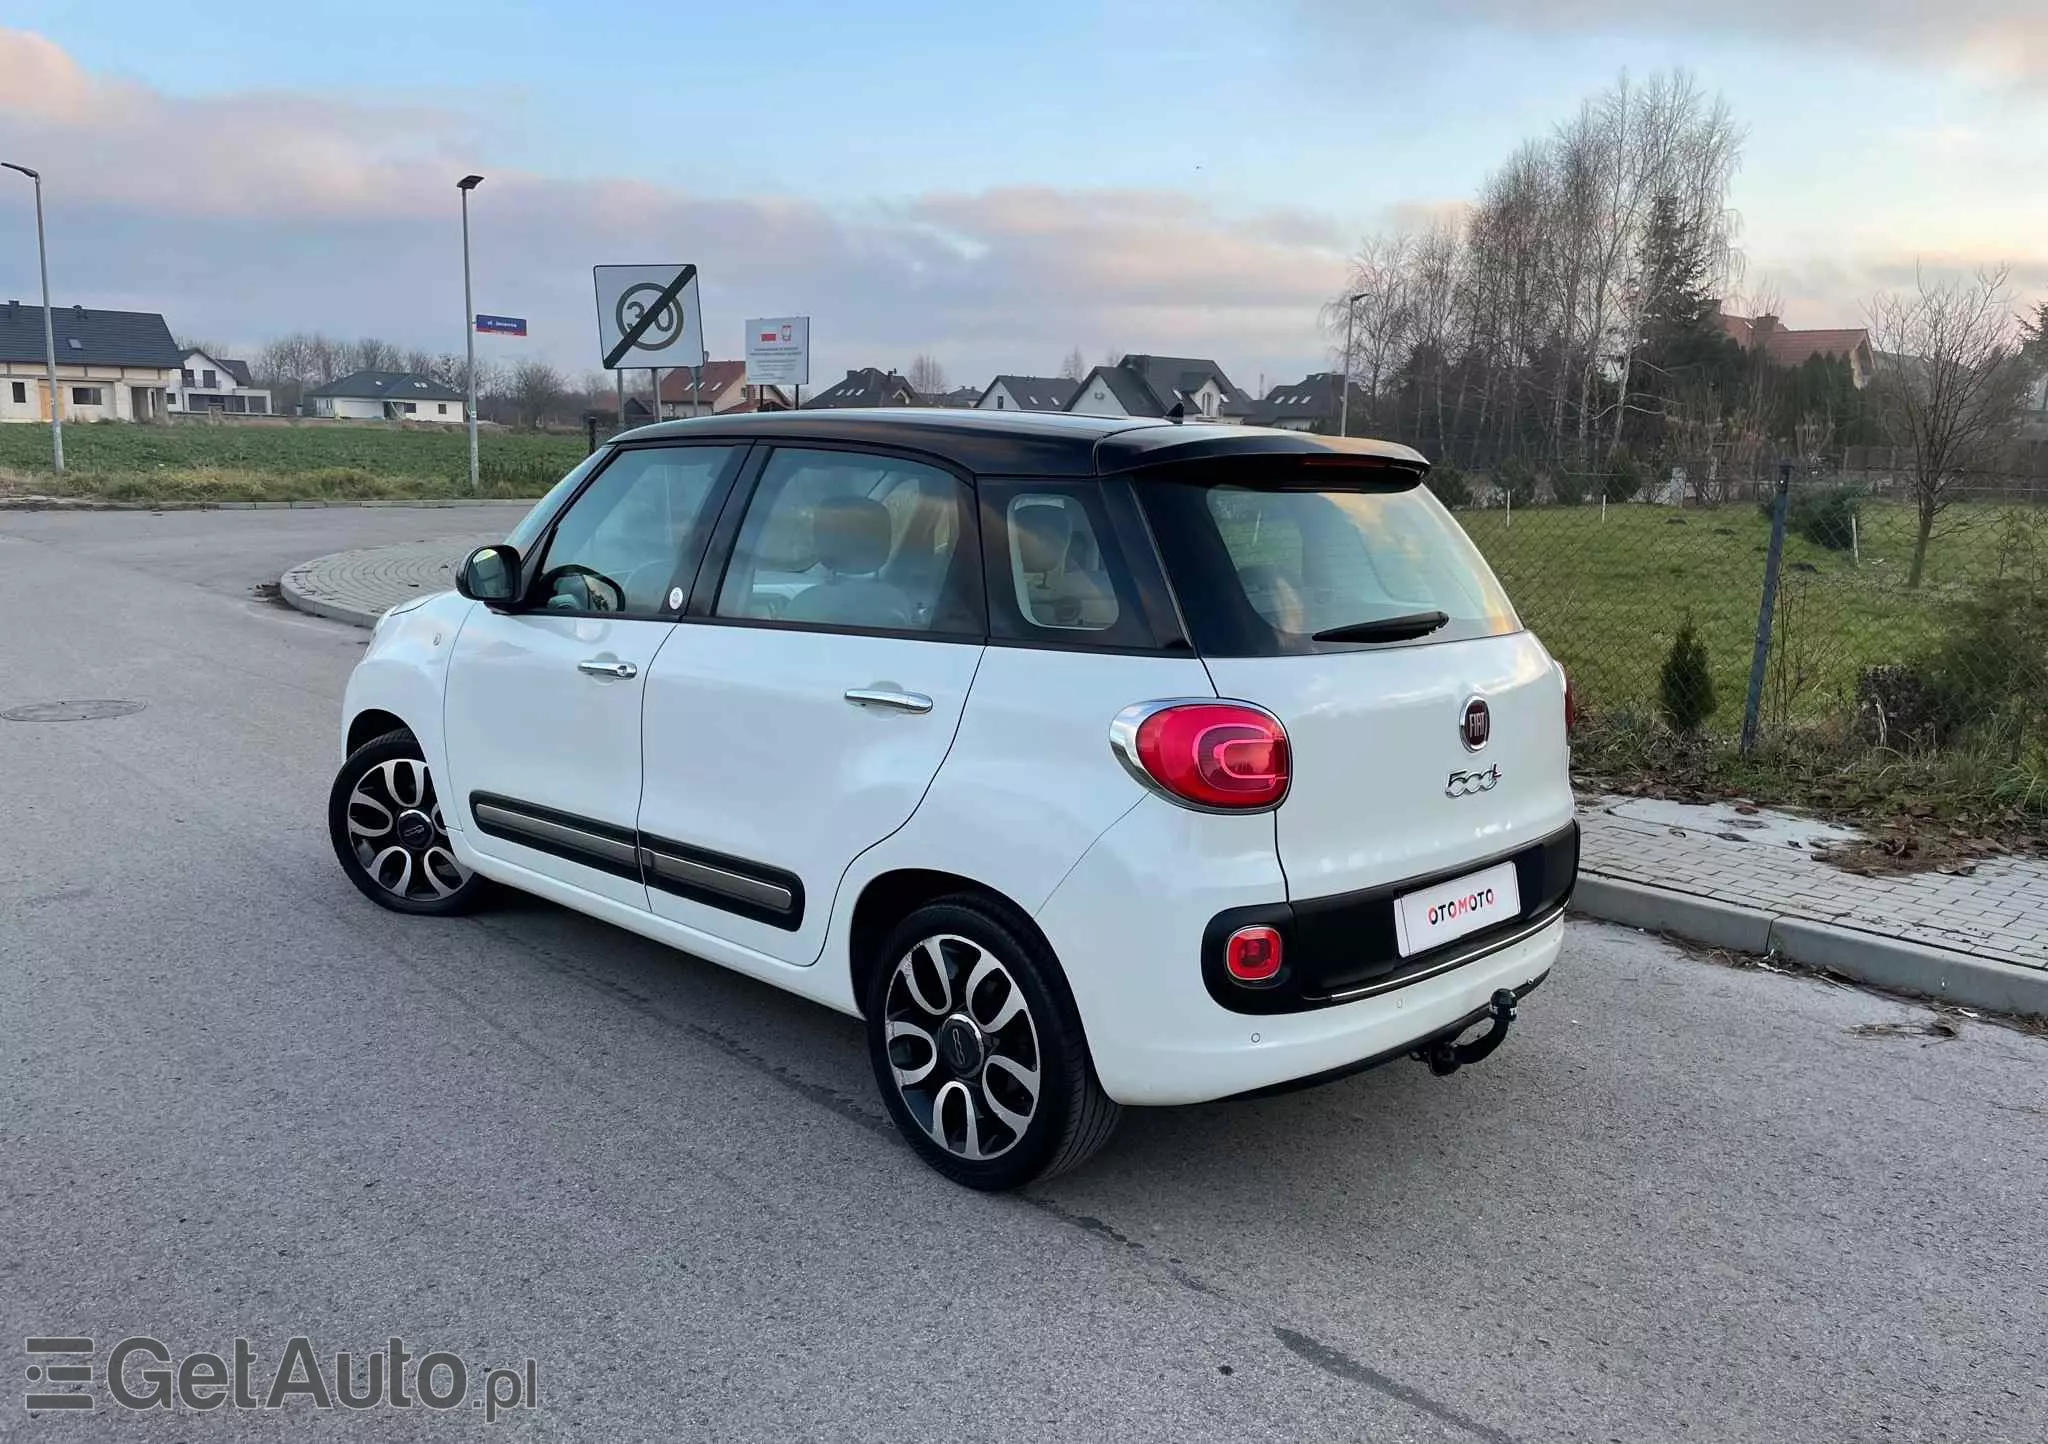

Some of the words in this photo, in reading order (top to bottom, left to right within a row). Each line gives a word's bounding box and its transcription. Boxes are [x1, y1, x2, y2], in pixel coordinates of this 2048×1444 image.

[627, 301, 674, 333] 30
[1469, 712, 1485, 737] FIAT
[1428, 888, 1494, 925] OTOMOTO
